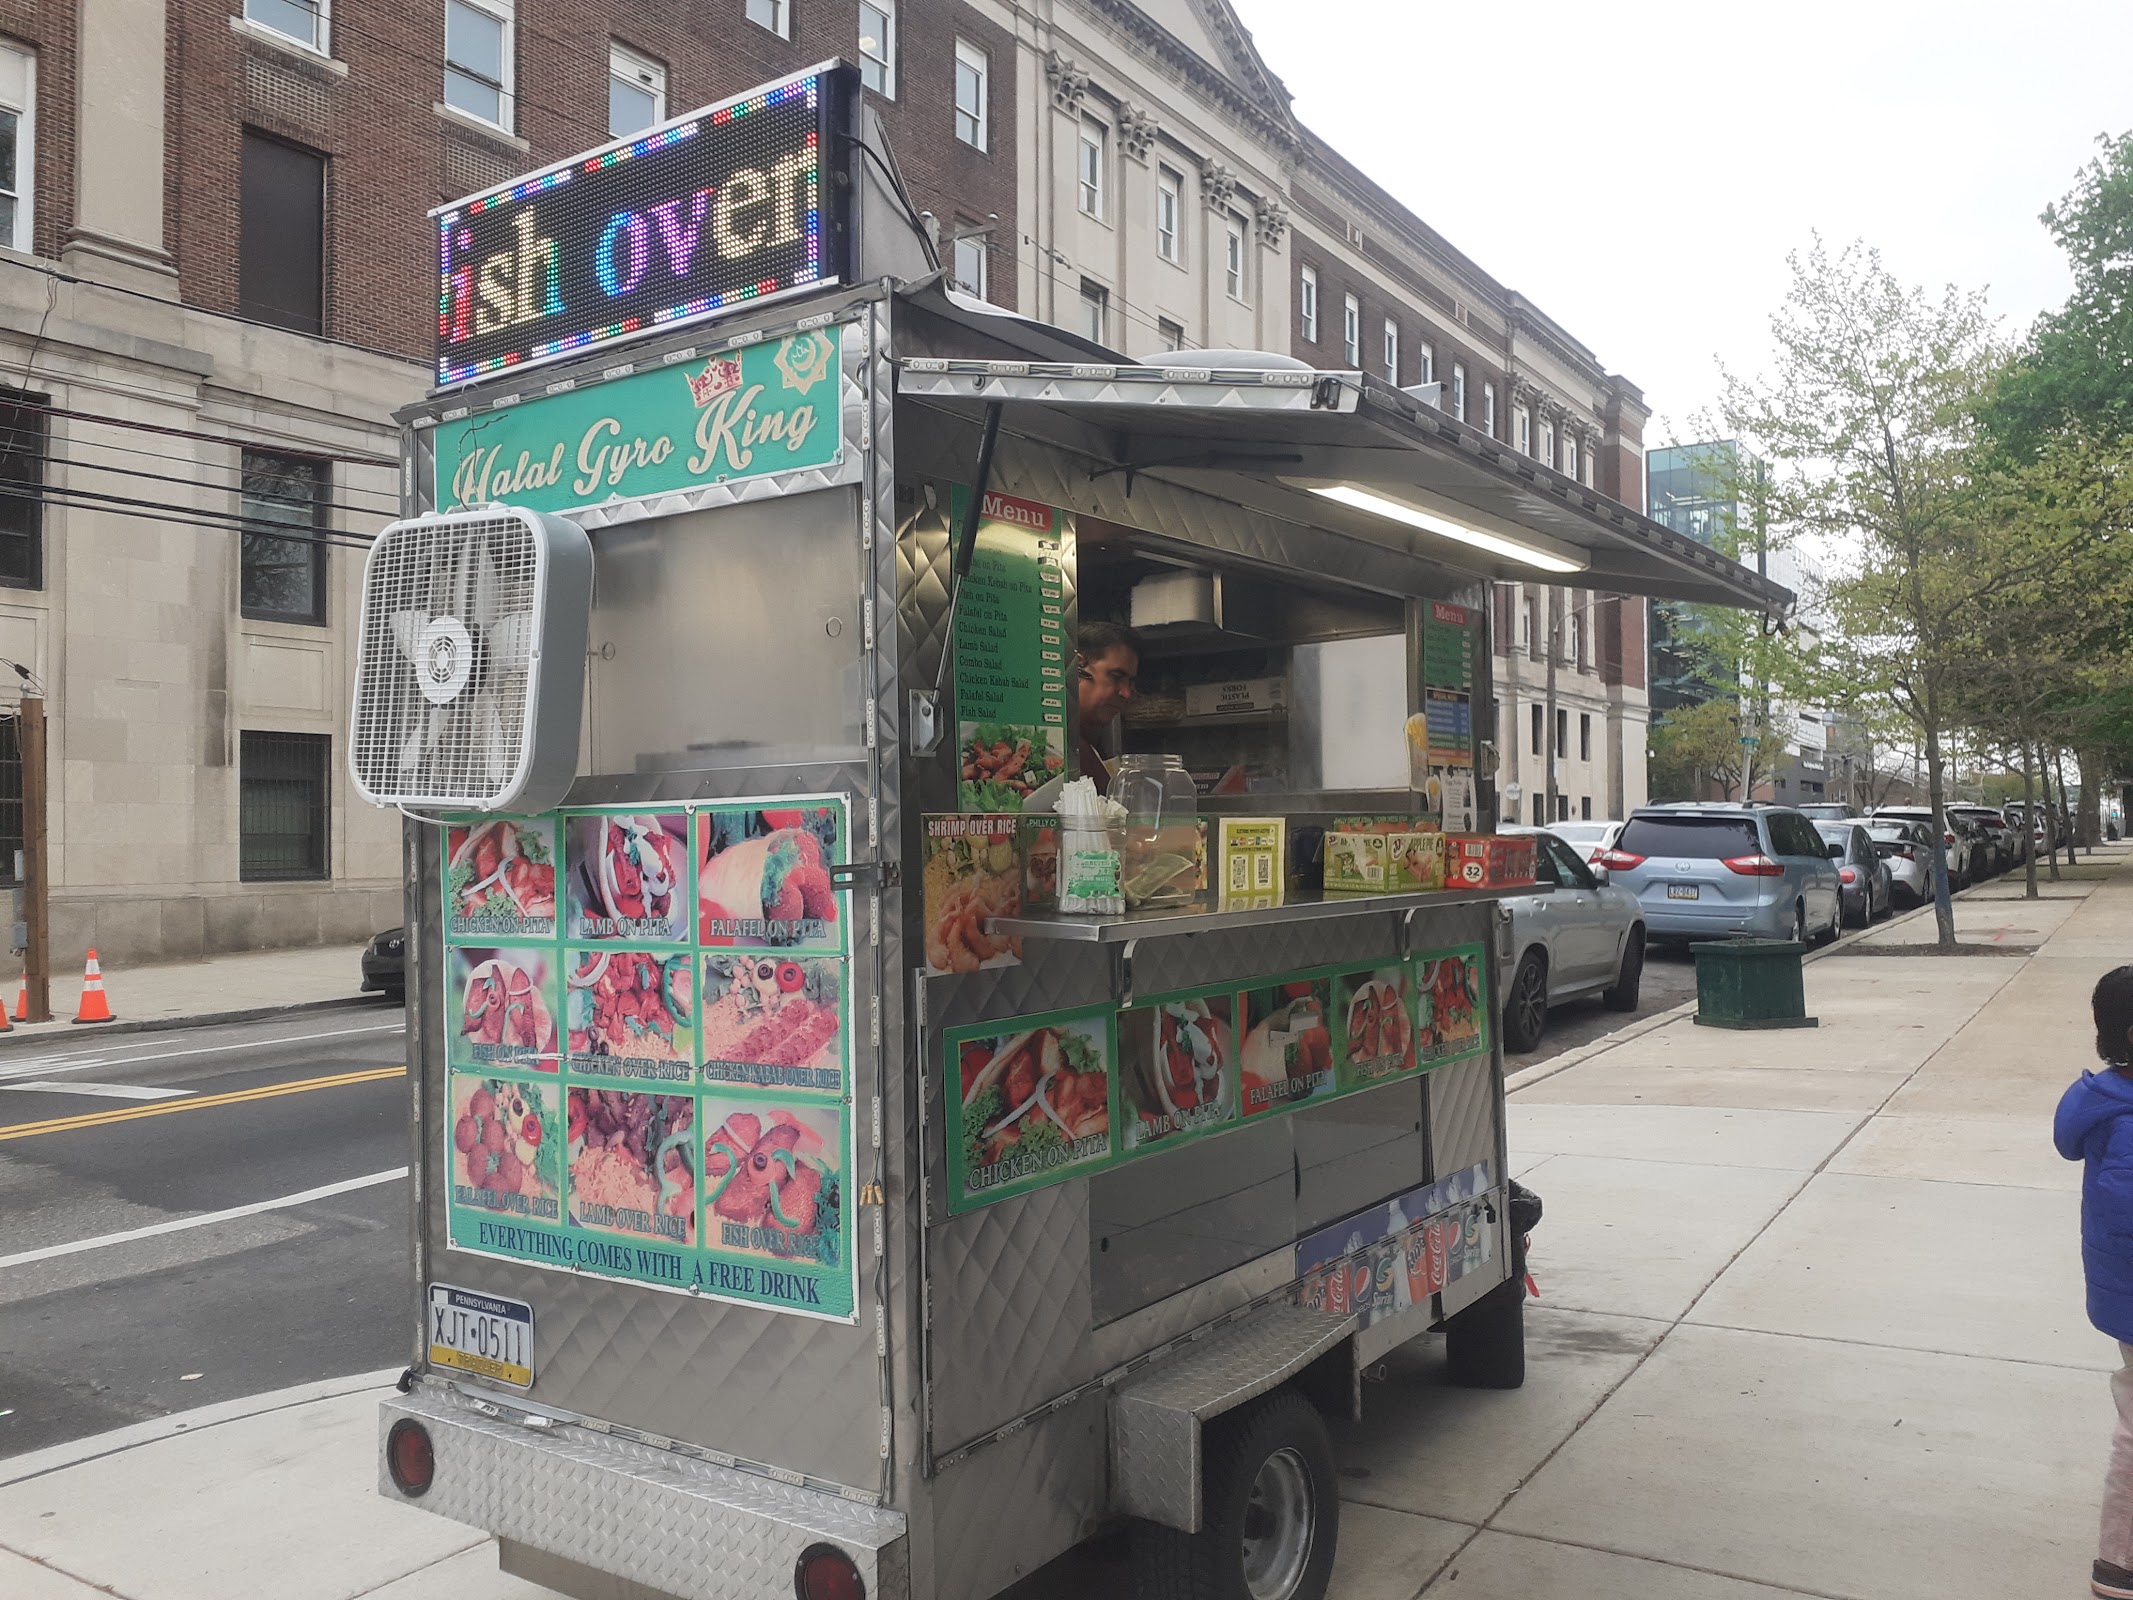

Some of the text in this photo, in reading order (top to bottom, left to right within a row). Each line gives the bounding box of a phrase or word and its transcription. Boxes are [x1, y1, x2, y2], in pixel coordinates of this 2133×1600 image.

[595, 145, 817, 298] over
[452, 384, 818, 504] Halal Gyro King
[981, 494, 1045, 527] Menu
[986, 592, 999, 604] Pita
[960, 605, 982, 618] Falafel
[994, 610, 1008, 621] Pita
[1435, 604, 1464, 624] Menu
[959, 621, 1007, 638] Chicken Salad
[960, 639, 999, 653] Lamb Salad
[960, 656, 1002, 670] Combo Salad
[960, 673, 988, 685] Chicken
[1012, 677, 1029, 689] Salad
[1223, 683, 1247, 692] FORKS
[960, 689, 1004, 702] Falafel Salad
[1221, 692, 1250, 701] PLASTIC
[961, 706, 997, 719] Fish Salad
[928, 818, 1017, 837] SHRIMP OVER RICE
[1028, 818, 1050, 828] PHILLY
[1466, 866, 1480, 877] 32
[450, 916, 551, 934] CHICKEN ON PITA
[580, 917, 672, 936] LAMB ON PITA
[710, 918, 827, 938] FALAFEL ON PITA
[473, 1043, 495, 1061] FISH
[496, 1044, 513, 1062] ON
[571, 1053, 690, 1080] CHICKEN OVER RICE
[706, 1060, 842, 1089] CHICKEN KABAB OVER RICE
[1250, 1070, 1328, 1105] FALAFEL ON PITA
[1136, 1100, 1222, 1140] LAMB ON PITA
[969, 1133, 1108, 1191] CHICKEN ON PITA
[455, 1185, 559, 1219] FALAFEL OVER RICE
[580, 1201, 687, 1239] LAMB OVER RICE
[722, 1222, 750, 1249] FISH
[750, 1226, 786, 1252] OVER
[478, 1221, 822, 1305] EVERYTHING COMES WITH A FREE DRINK
[455, 1294, 507, 1314] PENNSYLVANIA
